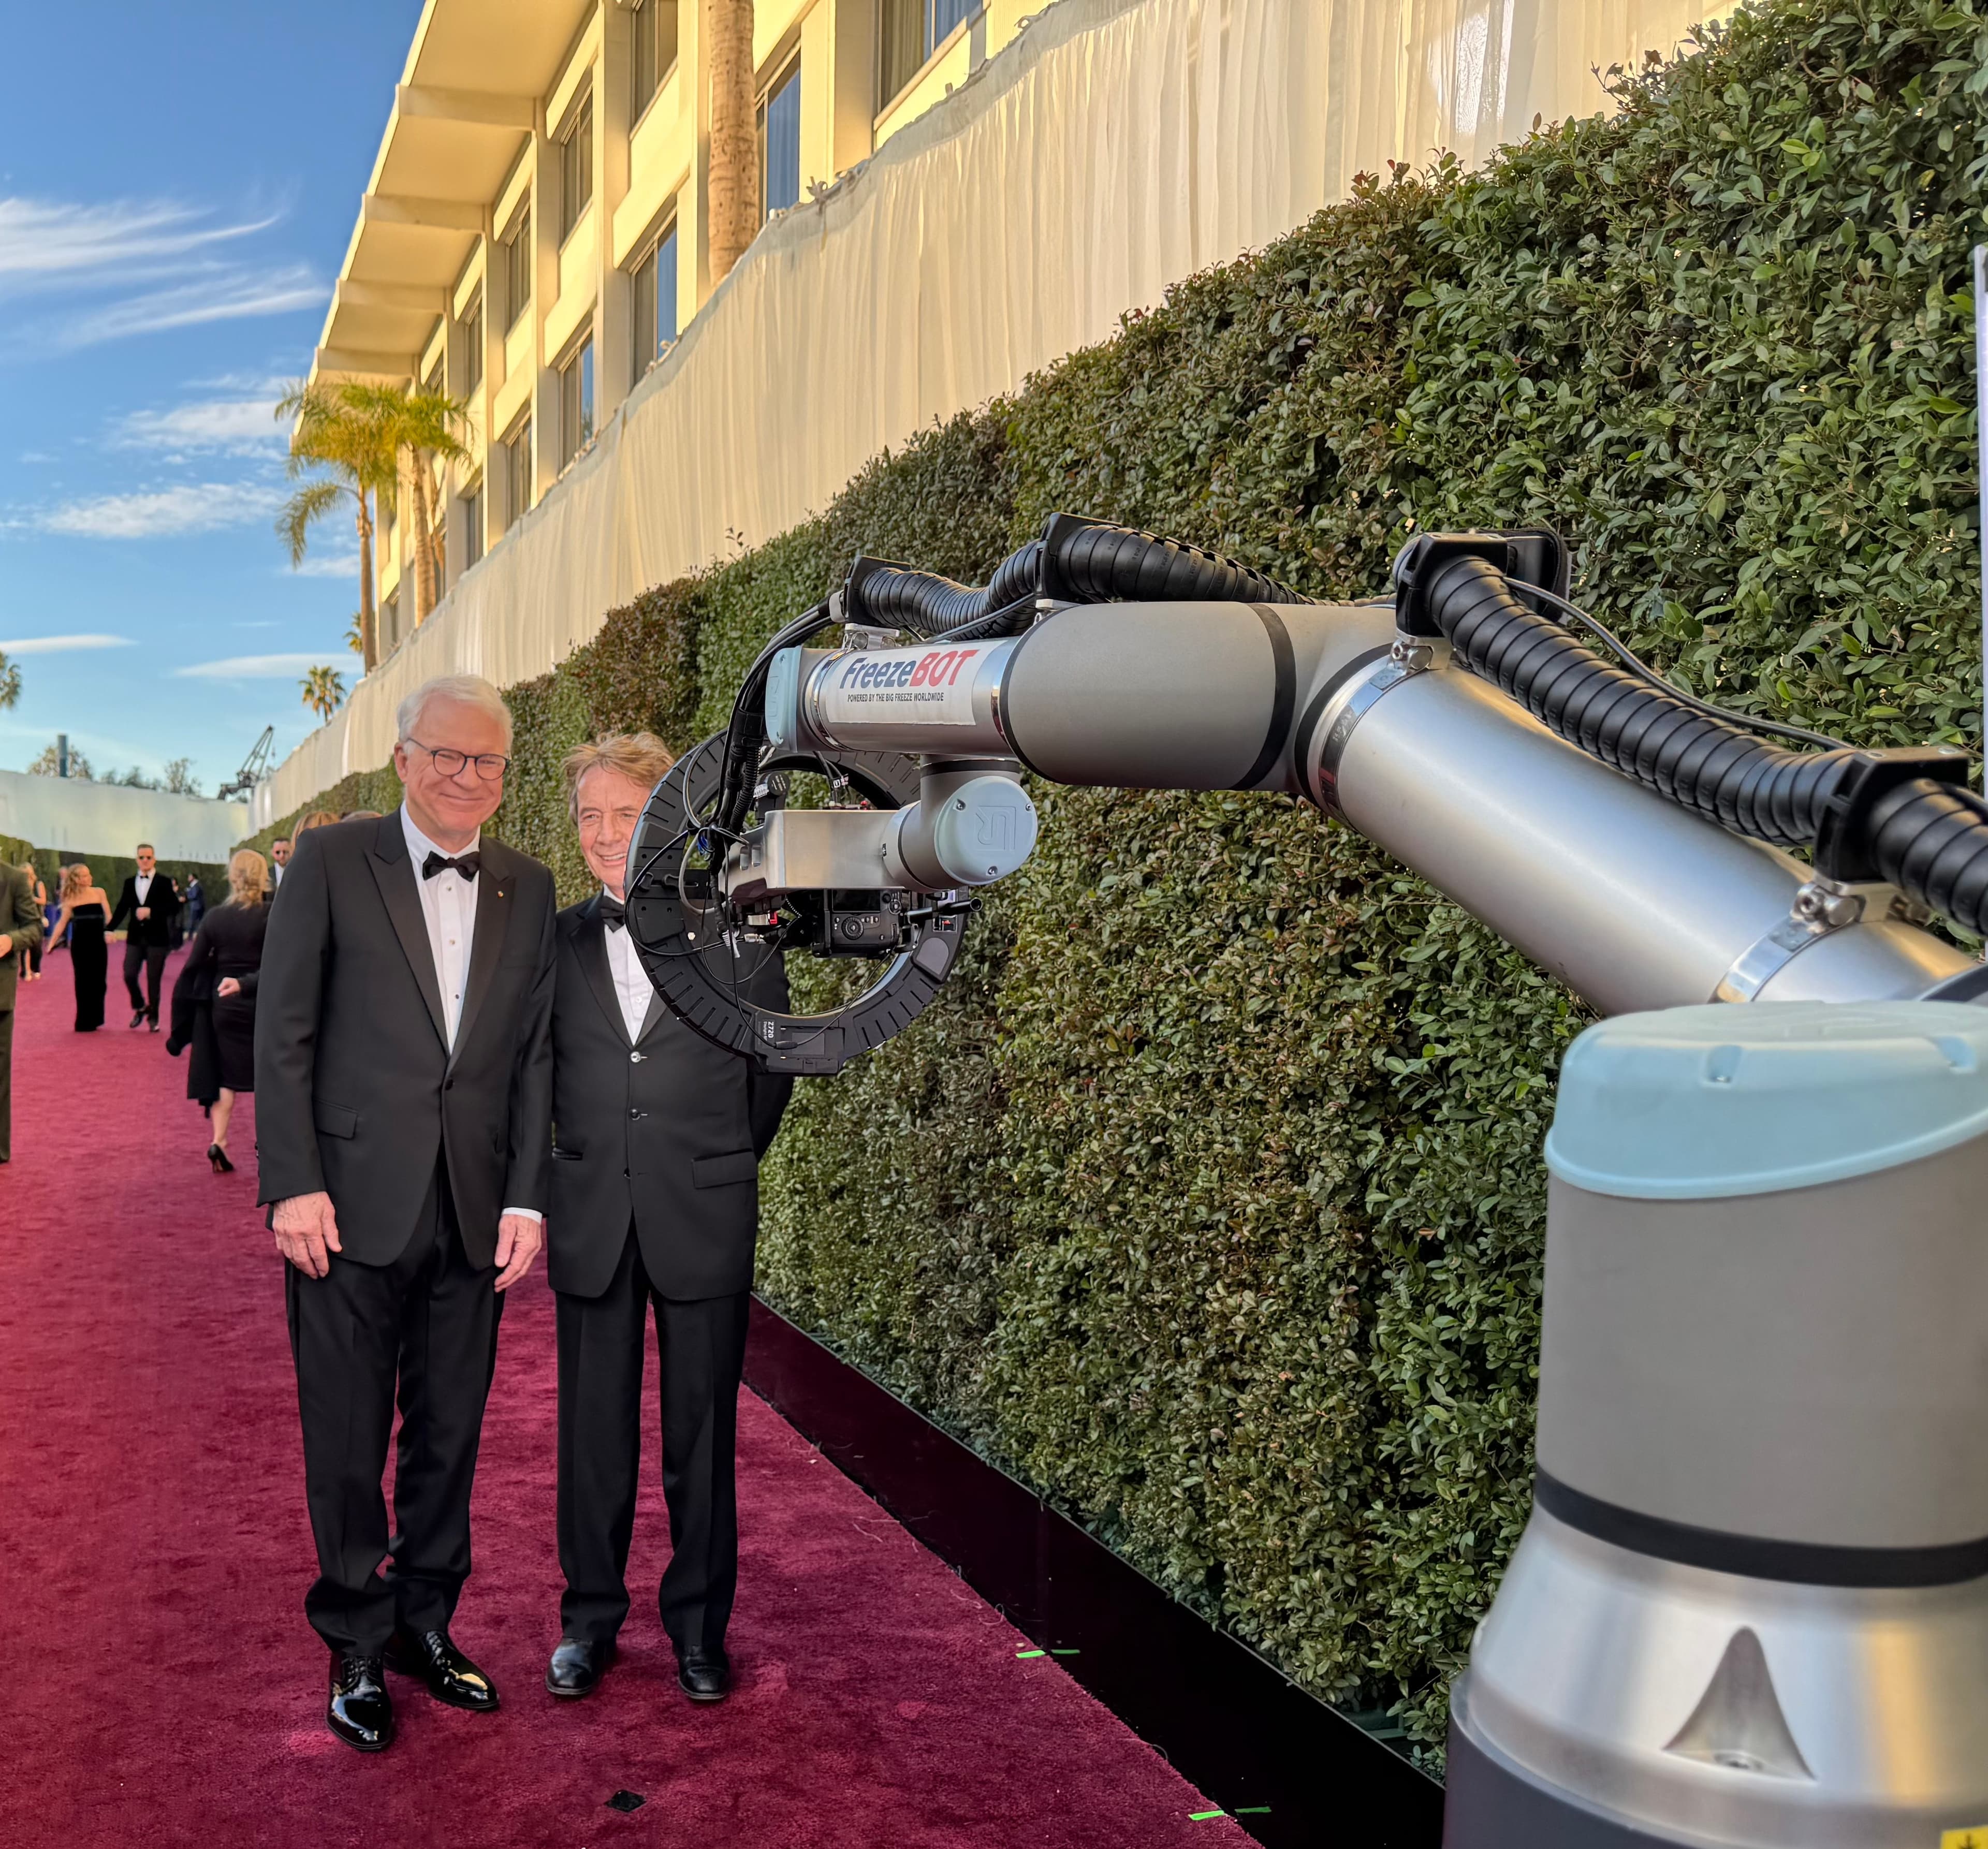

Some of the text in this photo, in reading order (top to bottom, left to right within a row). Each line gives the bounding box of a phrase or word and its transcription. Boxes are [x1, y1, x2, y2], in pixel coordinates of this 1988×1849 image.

[840, 649, 980, 689] FreezeBOT
[876, 694, 885, 702] THE
[895, 693, 912, 701] FREEZE
[913, 693, 944, 701] WORLDWIDE
